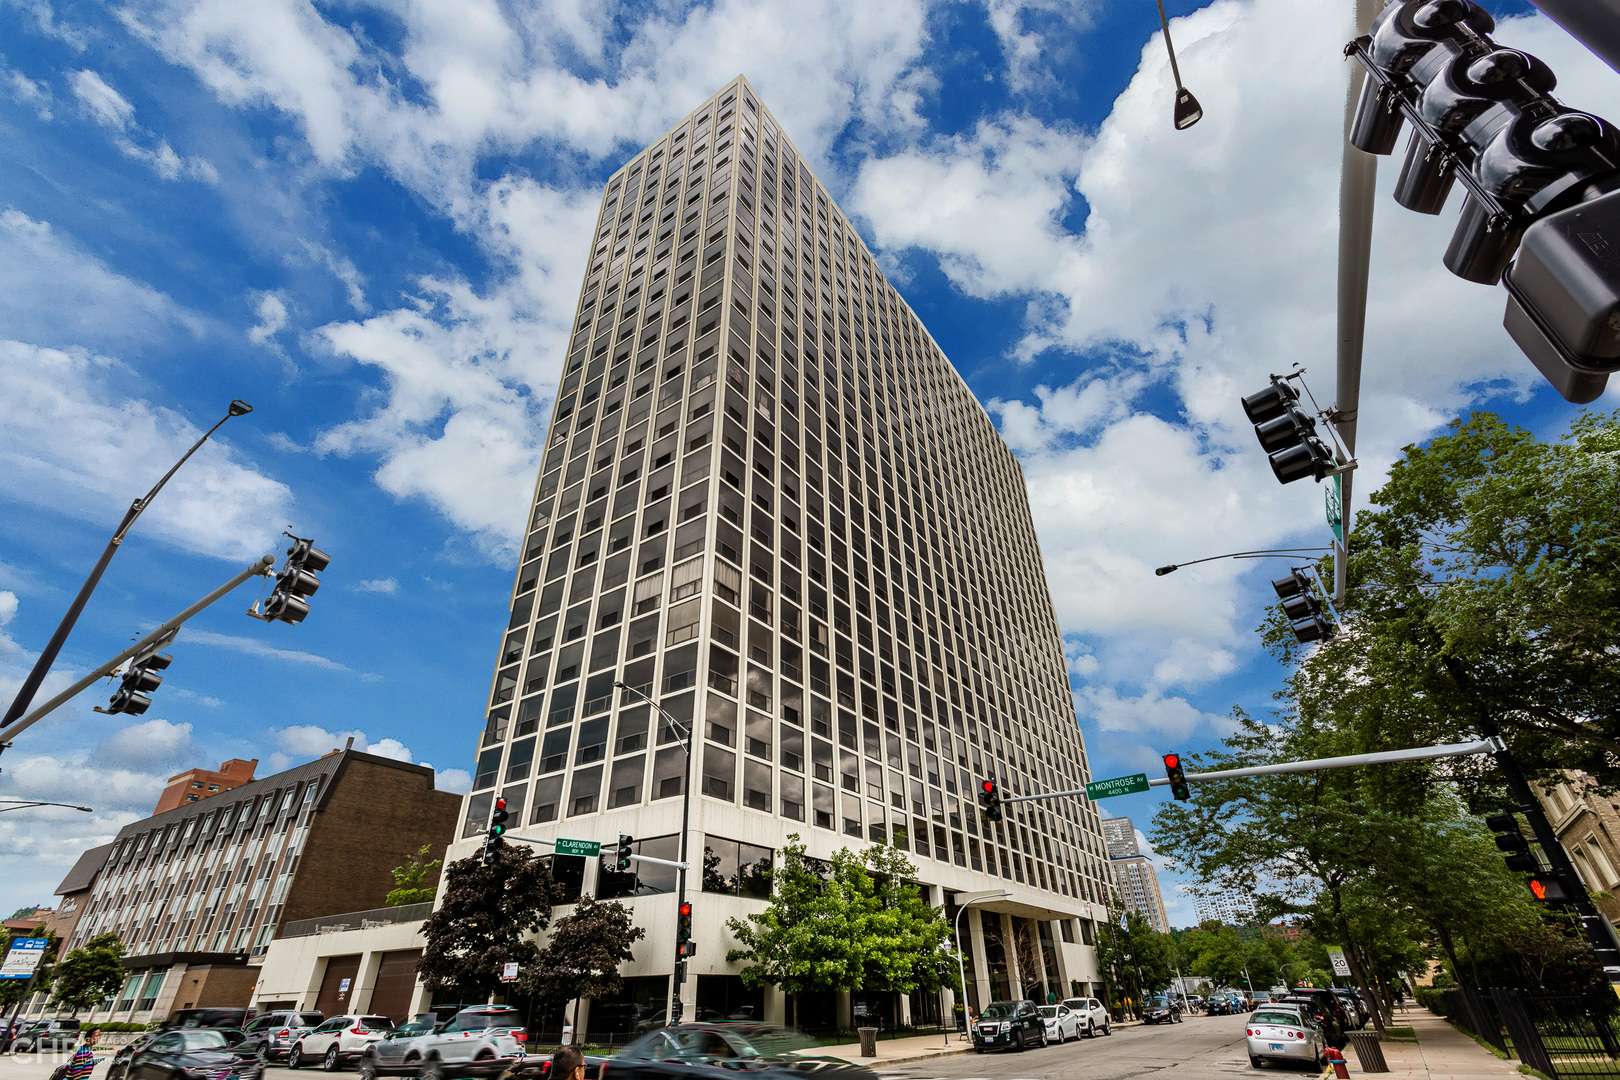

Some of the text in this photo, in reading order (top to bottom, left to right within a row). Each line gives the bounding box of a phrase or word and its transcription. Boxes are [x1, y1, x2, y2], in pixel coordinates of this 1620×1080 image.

[1095, 777, 1135, 791] MONTROSE
[562, 840, 592, 849] CLARENDON
[1333, 959, 1345, 967] 20
